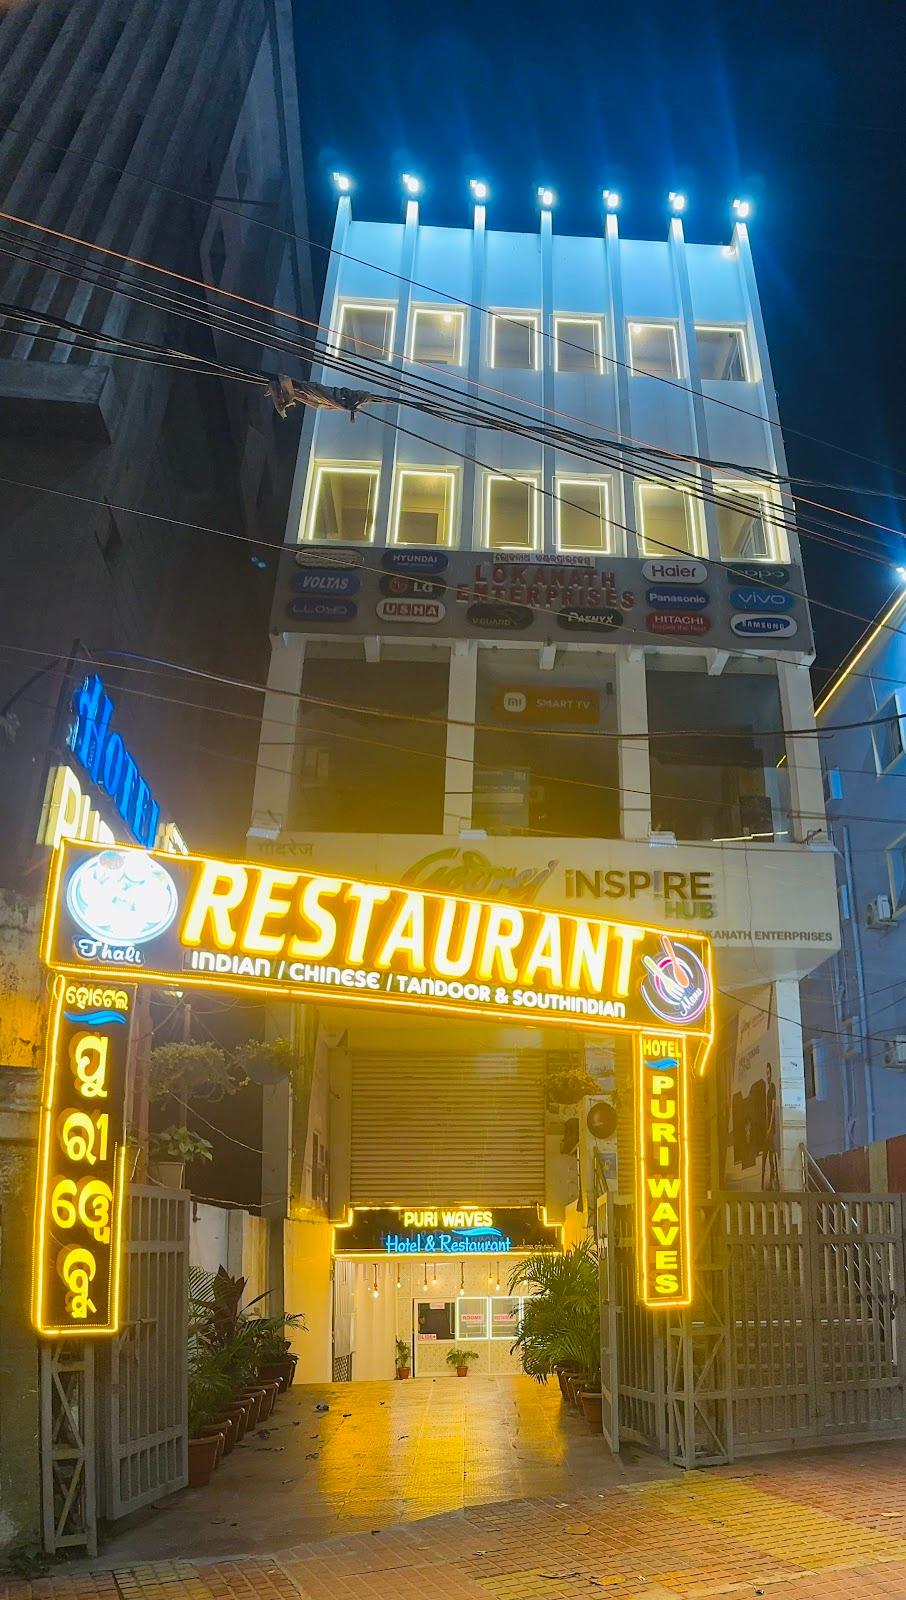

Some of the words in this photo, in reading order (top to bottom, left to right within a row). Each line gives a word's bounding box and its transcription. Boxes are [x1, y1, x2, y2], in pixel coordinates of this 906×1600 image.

[393, 554, 438, 563] HYUNDAI
[475, 564, 616, 590] LOKANATH
[651, 564, 697, 578] Haier
[303, 575, 349, 590] VOLTAS
[456, 583, 636, 612] ENTERPRISES
[650, 592, 706, 604] Panasonic
[383, 603, 440, 617] USHA
[654, 615, 704, 625] HITACHI
[741, 621, 785, 630] SAMSUNG
[536, 698, 572, 709] SMART
[576, 701, 591, 710] TV
[664, 901, 713, 919] HUB
[182, 860, 646, 1000] RESTAURANT
[754, 931, 833, 942] ENTERPRISES
[78, 938, 142, 964] Thali
[397, 975, 491, 1003] TANDOOR
[642, 1039, 683, 1058] HOTEL
[650, 1074, 678, 1167] PURI
[404, 1211, 438, 1228] PURI
[441, 1211, 493, 1228] WAVES
[386, 1233, 421, 1253] Hotel
[424, 1235, 436, 1252] &
[440, 1235, 512, 1253] Restaurant
[647, 1178, 682, 1294] WAVES
